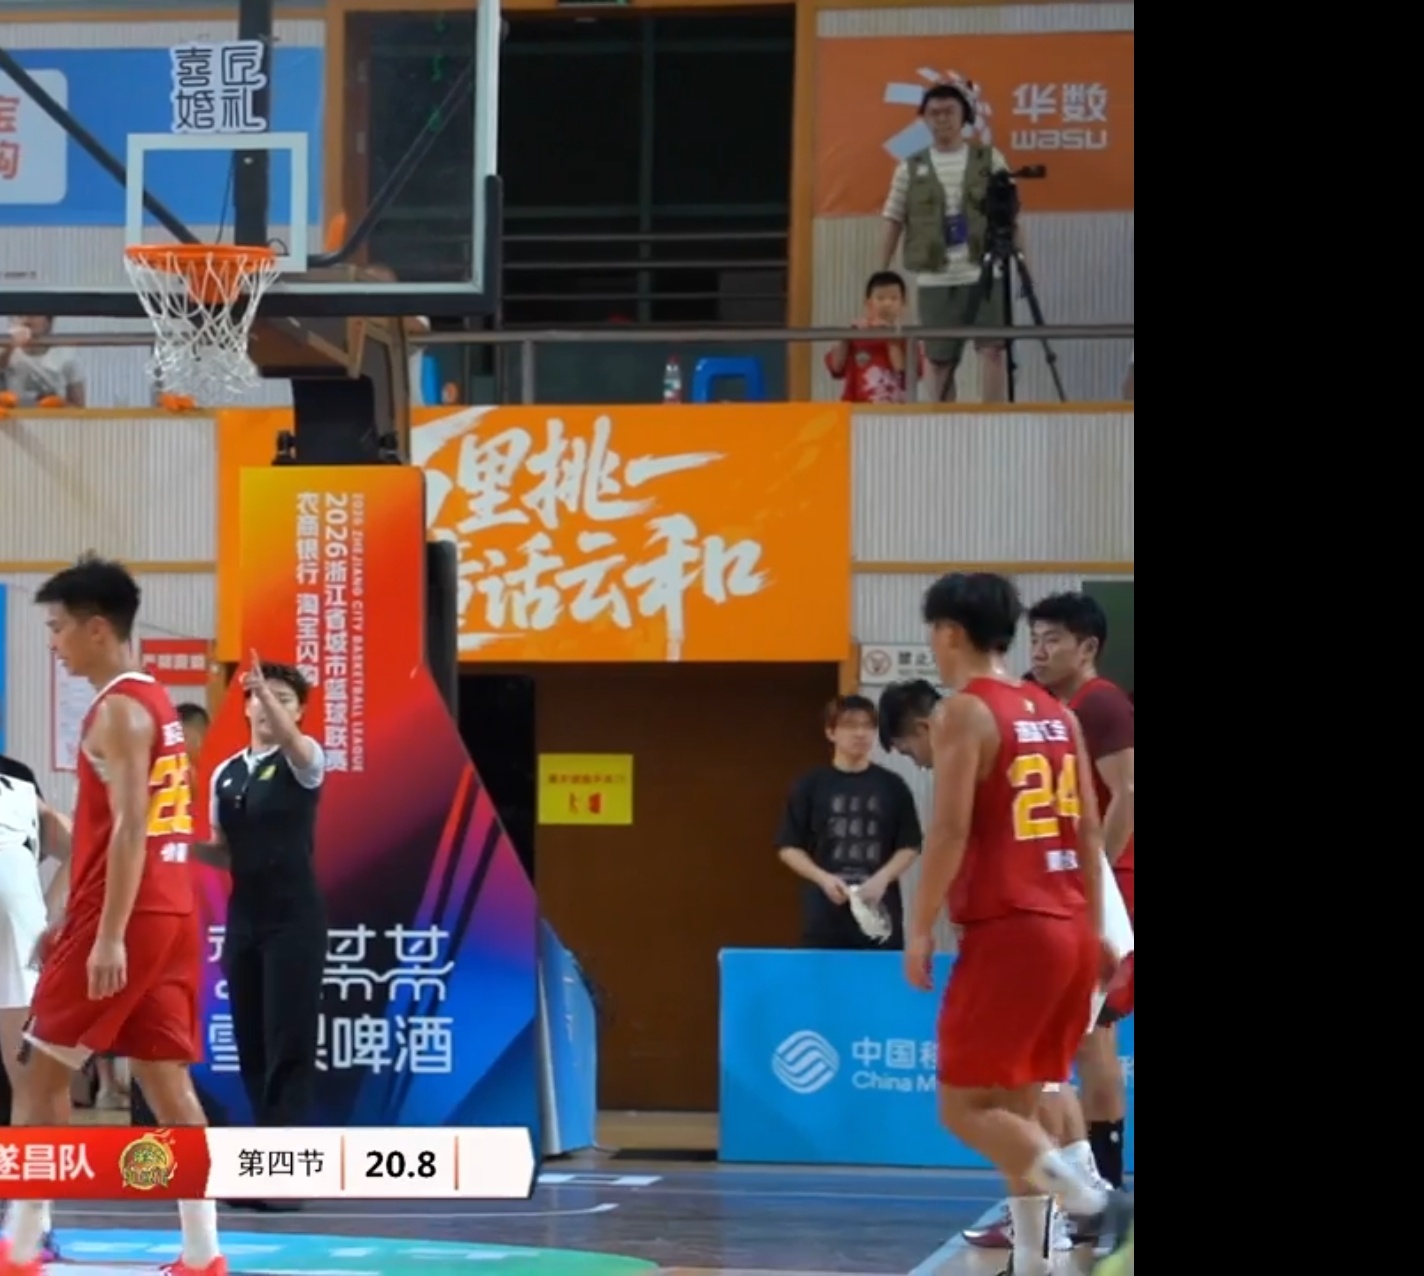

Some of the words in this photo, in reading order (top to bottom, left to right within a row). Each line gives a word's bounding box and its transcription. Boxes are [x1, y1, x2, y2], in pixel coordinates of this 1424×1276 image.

[1012, 83, 1107, 122] 华数
[1007, 753, 1081, 841] 24
[852, 1071, 913, 1092] China
